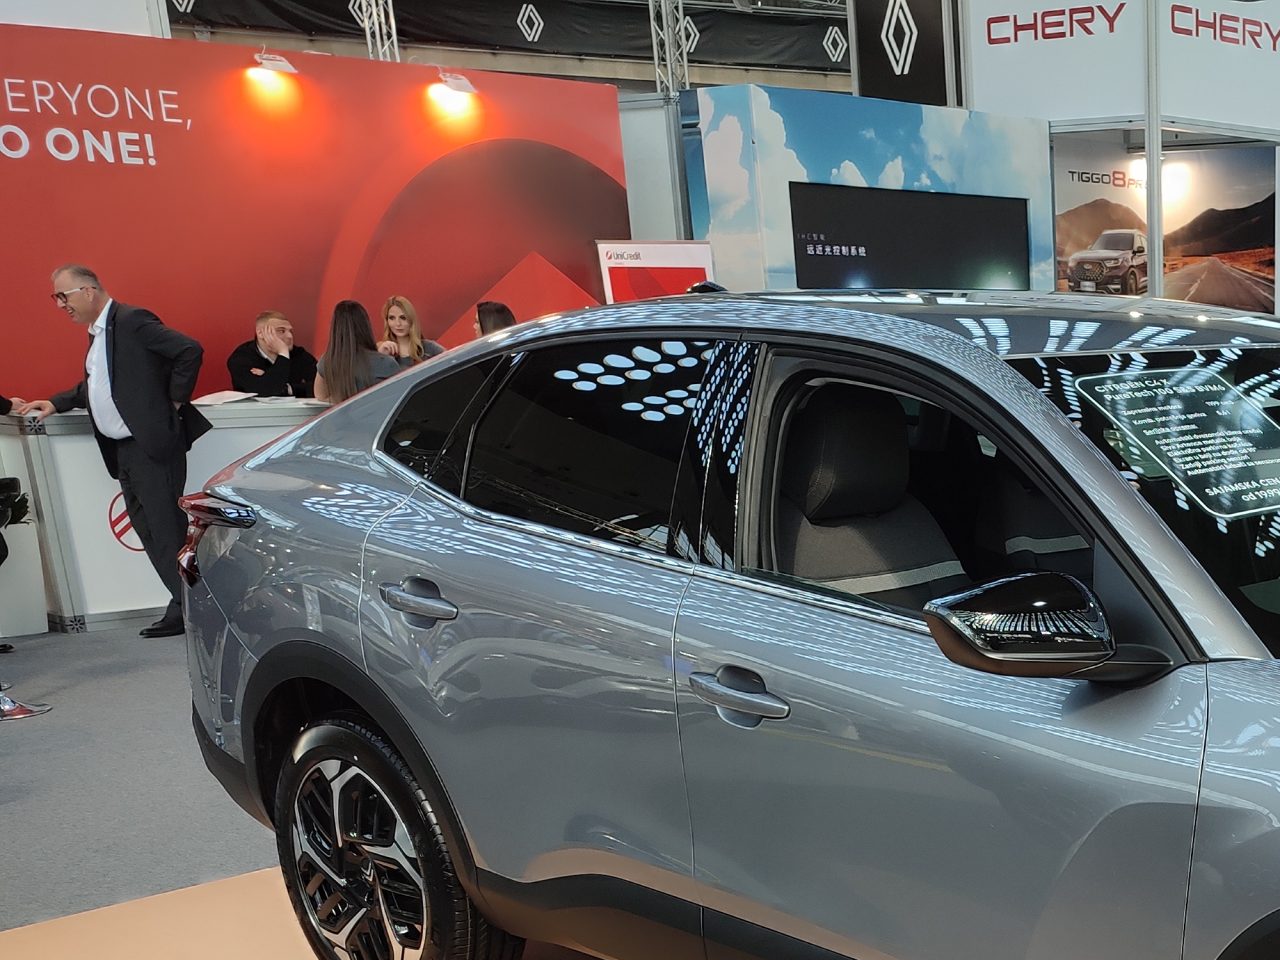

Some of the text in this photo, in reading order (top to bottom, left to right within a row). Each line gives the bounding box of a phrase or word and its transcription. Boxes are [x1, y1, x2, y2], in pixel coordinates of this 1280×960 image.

[987, 2, 1127, 45] CHERY
[45, 127, 157, 166] ONE!
[613, 251, 642, 261] UniCredit
[1094, 381, 1146, 392] CITROËN
[1104, 390, 1155, 400] PureTech
[1205, 481, 1260, 495] SAJAMSKA
